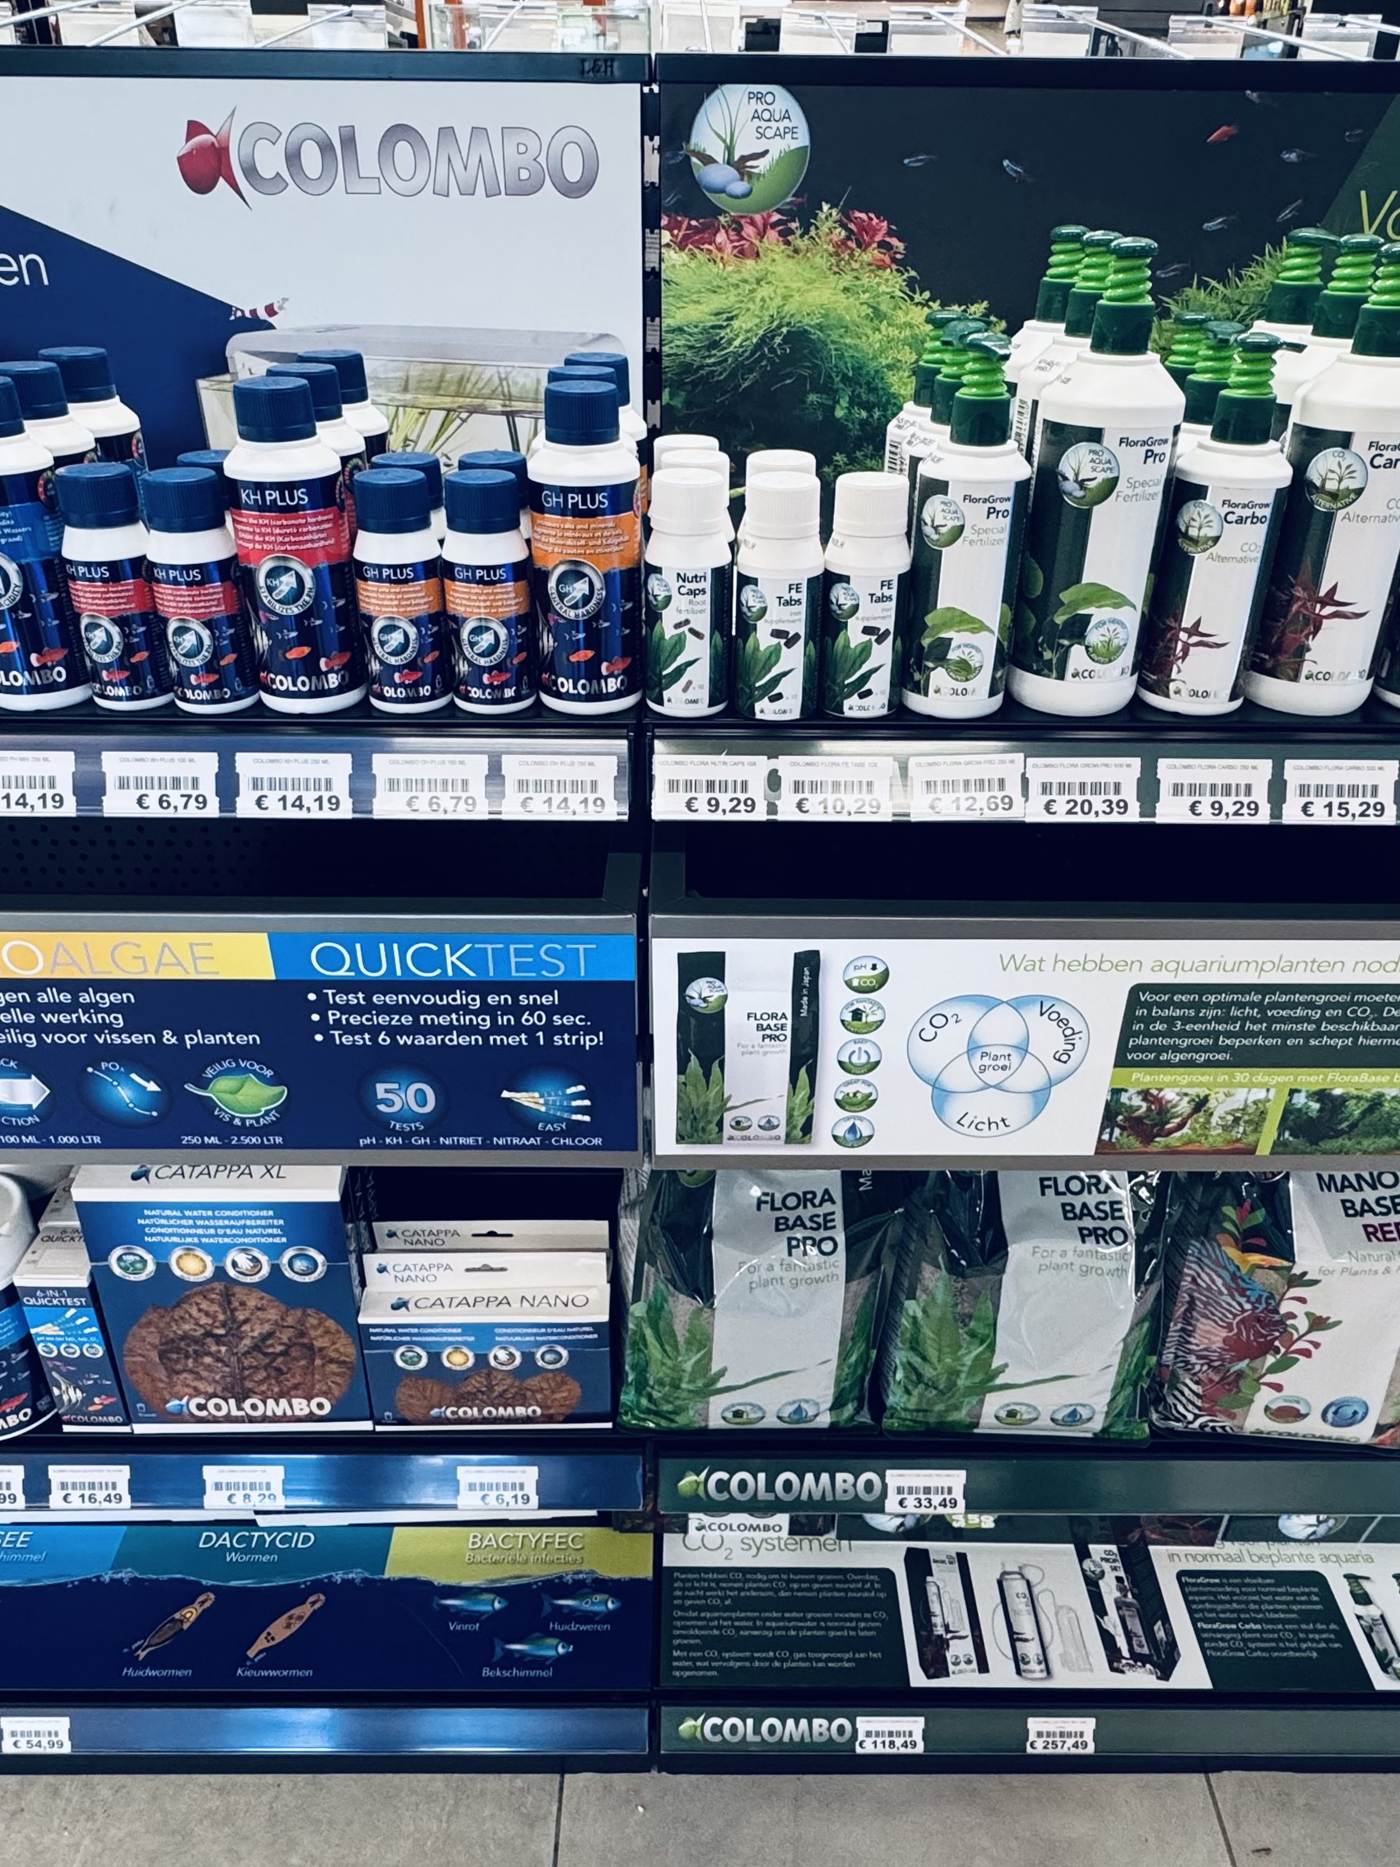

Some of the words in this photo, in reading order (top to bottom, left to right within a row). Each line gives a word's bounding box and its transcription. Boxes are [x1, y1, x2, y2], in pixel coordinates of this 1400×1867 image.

[748, 91, 775, 106] PRO
[751, 108, 792, 123] AQUA
[755, 126, 799, 140] SCAPE
[237, 121, 600, 199] COLOMBO
[1119, 436, 1169, 449] FloraGrow
[1144, 449, 1166, 465] Pro
[241, 488, 262, 506] KH
[265, 488, 309, 506] PLUS
[541, 490, 564, 508] GH
[568, 491, 608, 509] PLUS
[962, 494, 1011, 505] FloraGrow
[1221, 499, 1270, 510] FloraGrow
[987, 506, 1010, 520] Pro
[1224, 511, 1268, 526] Carbo
[169, 569, 201, 582] PLUS
[363, 566, 378, 579] GH
[382, 567, 415, 580] PLUS
[455, 567, 472, 580] GH
[476, 568, 507, 581] PLUS
[675, 571, 707, 585] Nutri
[677, 585, 707, 598] Caps
[788, 582, 803, 594] FE
[880, 579, 894, 591] FE
[776, 596, 802, 608] Tabs
[868, 593, 894, 604] Tabs
[267, 672, 348, 692] COLOMBO
[1, 792, 65, 812] 14,19
[136, 793, 150, 810] €
[157, 793, 208, 813] 6,79
[255, 795, 269, 811] €
[278, 794, 341, 814] 14,19
[406, 796, 420, 812] €
[428, 795, 477, 815] 6,79
[520, 796, 534, 813] €
[543, 796, 606, 816] 14,19
[685, 797, 699, 813] €
[706, 796, 757, 815] 9,29
[796, 797, 810, 813] €
[819, 797, 881, 816] 10,29
[929, 797, 942, 813] €
[951, 795, 1014, 816] 12,69
[1043, 799, 1057, 815] €
[1065, 798, 1128, 817] 20,39
[1188, 800, 1202, 816] €
[1210, 800, 1260, 819] 9,29
[1301, 801, 1315, 817] €
[1323, 801, 1386, 819] 15,29
[1, 939, 220, 977] OALGAE
[310, 941, 597, 978] QUICKTEST
[999, 953, 1047, 973] Wat
[1052, 952, 1143, 973] hebben
[1150, 954, 1346, 979] aquariumplanten
[37, 987, 72, 1004] alle
[78, 987, 135, 1008] algen
[324, 988, 367, 1006] Test
[372, 989, 481, 1010] eenvoudig
[487, 992, 512, 1006] en
[519, 989, 560, 1006] snel
[1139, 991, 1170, 1002] Voor
[1173, 993, 1199, 1002] een
[1202, 991, 1262, 1006] optimale
[1265, 991, 1351, 1005] plantengroei
[1, 1007, 36, 1024] elle
[41, 1007, 124, 1027] werking
[328, 1009, 413, 1026] Precieze
[420, 1010, 491, 1029] meting
[498, 1010, 514, 1026] in
[521, 1010, 547, 1026] 60
[553, 1013, 592, 1027] sec.
[747, 1012, 788, 1022] FLORA
[1152, 1006, 1195, 1018] balans
[1199, 1006, 1225, 1020] zijn:
[1230, 1006, 1261, 1020] licht,
[1266, 1006, 1321, 1021] voeding
[756, 1023, 788, 1032] BASE
[1037, 1000, 1083, 1065] Voeding
[41, 1031, 88, 1045] voor
[94, 1029, 156, 1045] vissen
[162, 1030, 178, 1045] &
[185, 1029, 261, 1050] planten
[330, 1030, 373, 1046] Test
[378, 1030, 391, 1046] 6
[396, 1030, 483, 1046] waarden
[490, 1031, 528, 1046] met
[536, 1031, 545, 1046] 1
[553, 1030, 604, 1050] strip!
[762, 1033, 787, 1043] PRO
[980, 1051, 1012, 1062] Plant
[202, 1058, 237, 1080] VEILIG
[238, 1058, 275, 1079] VOOR
[978, 1061, 1012, 1075] groei
[1131, 1071, 1214, 1085] Plantengroei
[1217, 1071, 1229, 1082] in
[1231, 1072, 1250, 1083] 30
[1252, 1072, 1293, 1085] dagen
[1297, 1073, 1323, 1083] met
[1327, 1072, 1389, 1084] FloraBase
[375, 1082, 436, 1114] 50
[214, 1106, 231, 1122] VIS
[232, 1116, 243, 1127] &
[246, 1110, 282, 1127] PLANT
[956, 1111, 1011, 1132] Licht
[389, 1119, 425, 1132] TESTS
[537, 1121, 567, 1133] EASY
[181, 1134, 201, 1145] 250
[203, 1135, 223, 1145] ML
[230, 1135, 260, 1145] 2.500
[263, 1135, 284, 1145] LTR
[440, 1136, 483, 1146] NITRIET
[493, 1136, 542, 1146] NITRAAT
[551, 1136, 603, 1146] CHLOOR
[154, 1165, 253, 1181] CATAPPA
[259, 1165, 287, 1180] XL
[1039, 1174, 1121, 1197] FLORA
[1315, 1171, 1399, 1193] MANO
[756, 1187, 836, 1213] FLORA
[1061, 1201, 1125, 1221] BASE
[774, 1211, 837, 1233] BASE
[1077, 1226, 1128, 1246] PRO
[786, 1235, 839, 1258] PRO
[779, 1258, 840, 1273] fantastic
[749, 1275, 784, 1294] plant
[789, 1273, 839, 1290] growth
[23, 1296, 87, 1306] QUICKTEST
[414, 1295, 511, 1310] CATAPPA
[519, 1294, 589, 1309] NANO
[188, 1397, 332, 1418] COLOMBO
[446, 1405, 542, 1419] COLOMBO
[707, 1470, 882, 1502] COLOMBO
[78, 1492, 123, 1506] 16,49
[243, 1493, 277, 1507] 8,29
[495, 1493, 531, 1506] 6,19
[898, 1498, 907, 1509] €
[913, 1497, 958, 1511] 33,49
[708, 1522, 783, 1533] COLOMBO
[198, 1531, 315, 1549] DACTYCID
[468, 1532, 585, 1550] BACTYFEC
[740, 1536, 852, 1558] systemen
[225, 1551, 279, 1563] Wormen
[1185, 1552, 1246, 1564] normaal
[1249, 1550, 1315, 1567] beplante
[1319, 1552, 1376, 1567] aquaria
[448, 1621, 480, 1632] Vinrot
[549, 1621, 611, 1632] Huidzweren
[121, 1666, 193, 1678] Huidwormen
[236, 1666, 313, 1678] Kieuwwormen
[481, 1666, 553, 1678] Bekschimmel
[703, 1716, 853, 1743] COLOMBO
[26, 1739, 64, 1751] 54,99
[872, 1739, 918, 1751] 118,49
[1042, 1740, 1089, 1752] 257,49
